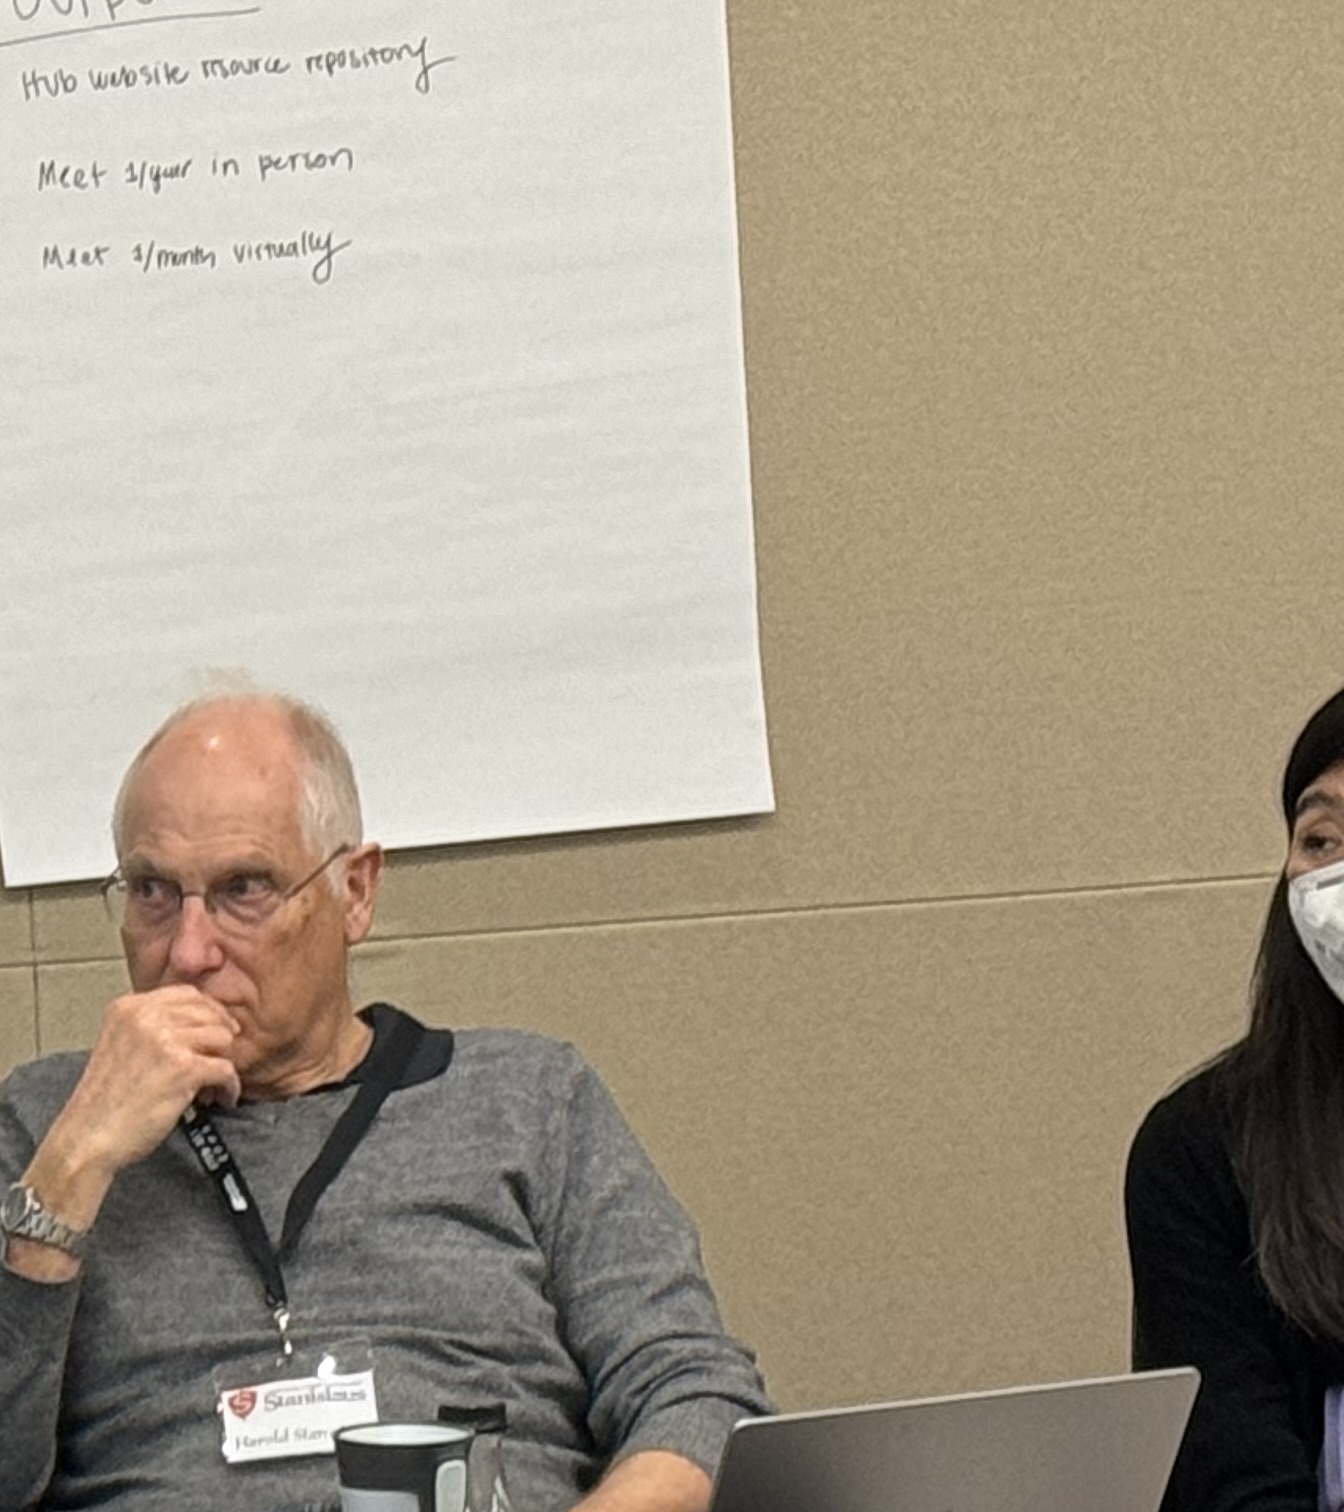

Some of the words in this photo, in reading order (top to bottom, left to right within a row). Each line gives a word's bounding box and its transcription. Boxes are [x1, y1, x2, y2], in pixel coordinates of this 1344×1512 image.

[21, 67, 79, 102] Hub
[36, 159, 110, 193] Meet
[211, 156, 241, 179] in
[41, 243, 112, 271] Meet
[232, 228, 353, 285] virtually
